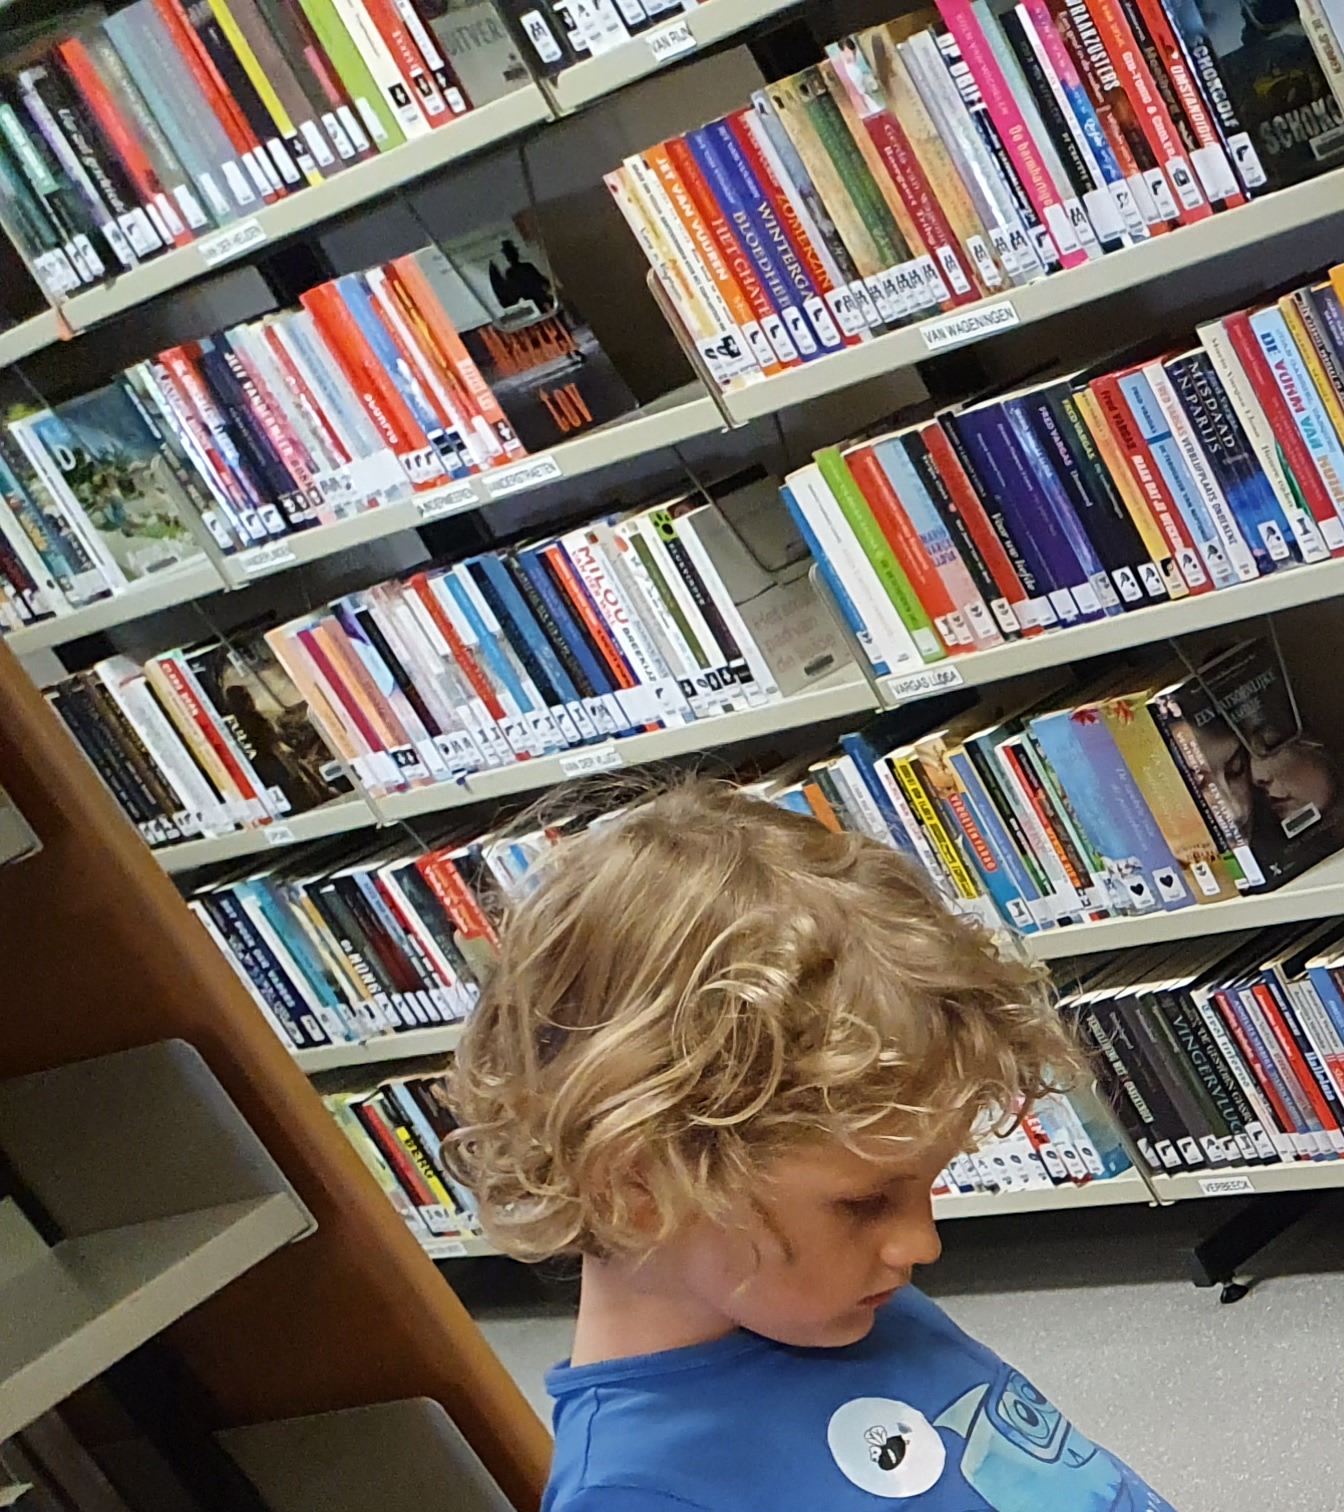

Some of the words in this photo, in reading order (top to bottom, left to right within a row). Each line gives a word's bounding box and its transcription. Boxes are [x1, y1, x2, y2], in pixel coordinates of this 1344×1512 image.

[656, 157, 675, 180] JET
[672, 184, 694, 218] VAN
[692, 219, 729, 281] VUUREN
[711, 218, 737, 256] HET
[924, 328, 947, 343] VAN
[946, 308, 1015, 337] WAGENINGEN
[1173, 369, 1192, 390] IN
[1185, 392, 1222, 454] PARIJS
[1188, 361, 1235, 449] MISDAAD
[1260, 332, 1282, 358] DE
[1273, 359, 1305, 413] VORM
[1298, 411, 1325, 449] VAN
[577, 546, 629, 625] MILOU
